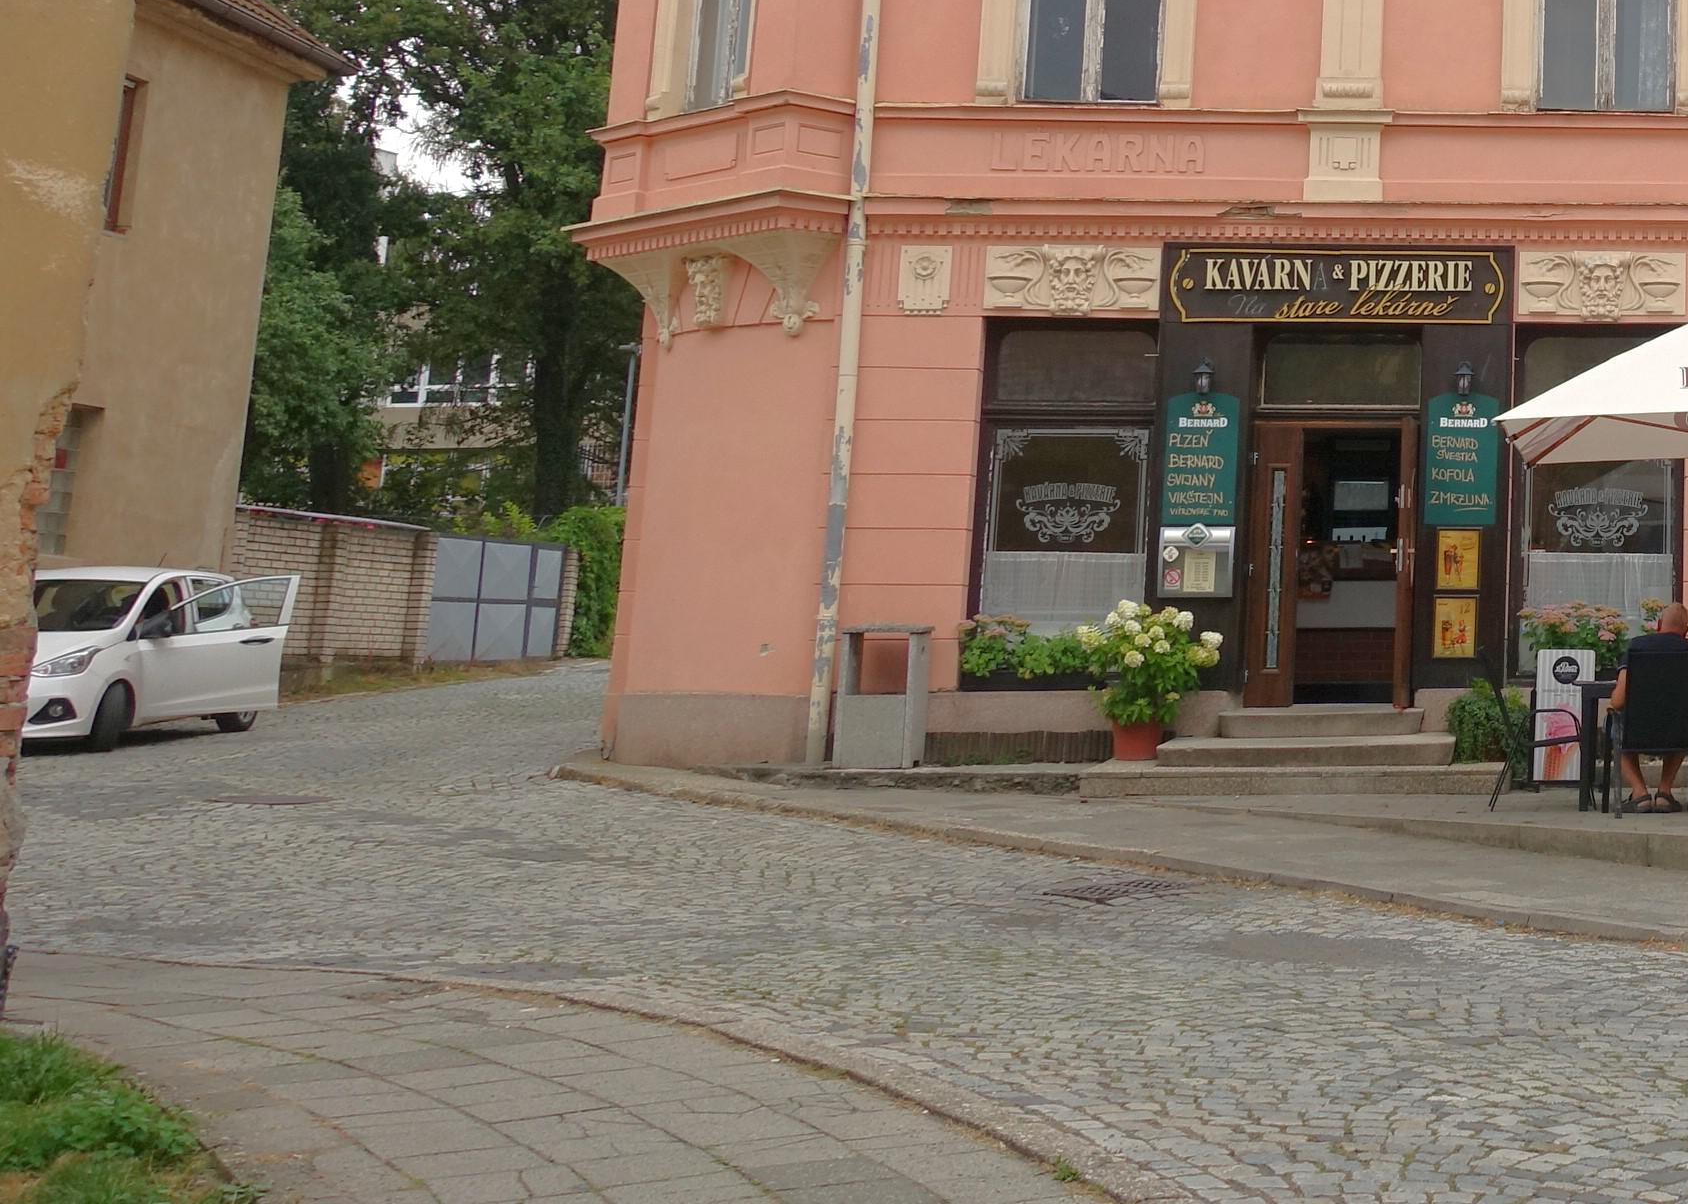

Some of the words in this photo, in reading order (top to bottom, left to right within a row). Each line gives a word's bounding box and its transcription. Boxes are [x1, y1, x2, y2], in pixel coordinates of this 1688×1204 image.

[1332, 263, 1345, 280] &
[1348, 259, 1473, 292] PIZZERIE
[1178, 417, 1229, 428] BERNARD
[1440, 417, 1489, 428] BERNARD
[1168, 429, 1214, 448] PLZEŇ
[1432, 434, 1479, 451] BERNARD
[1168, 453, 1225, 470] BERNARD
[1167, 473, 1216, 490] SVIJANY
[1431, 467, 1475, 483] KOFOLA
